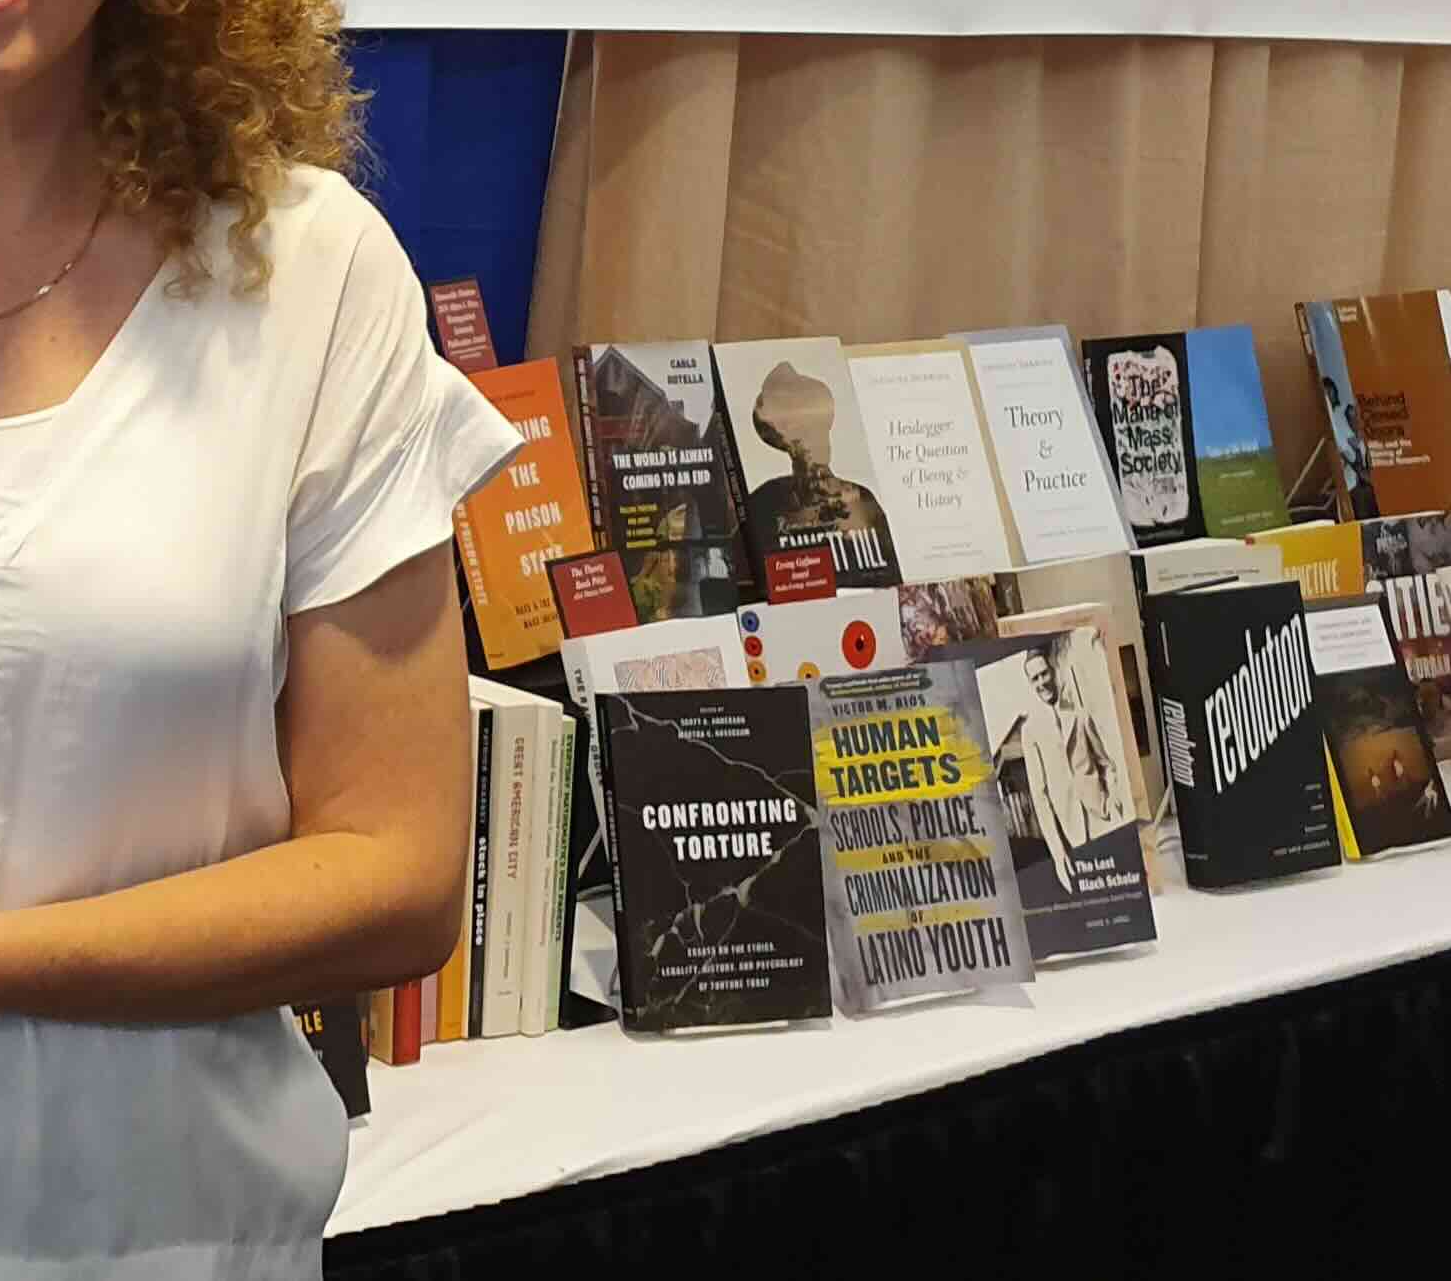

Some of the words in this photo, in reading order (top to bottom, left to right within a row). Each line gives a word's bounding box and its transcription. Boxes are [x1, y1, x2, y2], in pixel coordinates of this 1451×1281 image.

[1129, 374, 1159, 397] The
[1004, 404, 1063, 429] Theory
[1038, 439, 1053, 459] &
[1126, 425, 1172, 449] Mass
[613, 453, 630, 469] THE
[634, 451, 665, 467] WORLD
[669, 450, 677, 464] IS
[680, 448, 713, 464] ALWAYS
[887, 445, 910, 462] The
[916, 443, 968, 463] Question
[1121, 451, 1182, 475] Society
[509, 462, 540, 488] THE
[623, 474, 660, 490] COMING
[663, 472, 674, 487] TO
[678, 471, 690, 485] AN
[693, 469, 710, 485] END
[902, 470, 915, 488] of
[918, 469, 953, 486] Being
[1024, 469, 1086, 492] Practice
[917, 492, 963, 510] History
[505, 502, 562, 535] PRISON
[849, 527, 887, 569] TILL
[833, 700, 873, 716] VICTOR
[876, 698, 892, 711] M.
[896, 693, 926, 709] RIOS
[1205, 613, 1313, 794] revolution
[833, 716, 940, 758] HUMAN
[512, 736, 525, 777] GREAT
[830, 753, 961, 798] TARGETS
[508, 781, 523, 848] AMERICAN
[643, 798, 797, 830] CONFRONTING
[830, 804, 909, 852] SCHOOLS,
[910, 796, 986, 841] POLICE,
[476, 837, 487, 880] stuck
[674, 832, 772, 861] TORTURE
[882, 850, 903, 864] AND
[908, 846, 930, 860] THE
[507, 850, 519, 880] CITY
[1076, 859, 1092, 873] The
[475, 884, 485, 899] in
[845, 857, 996, 916] CRIMINALIZATION
[1079, 877, 1105, 892] Black
[1107, 872, 1140, 887] Scholar
[474, 903, 486, 947] place
[911, 910, 923, 922] OF
[858, 927, 926, 985] LATINO
[926, 918, 1010, 974] YOUTH
